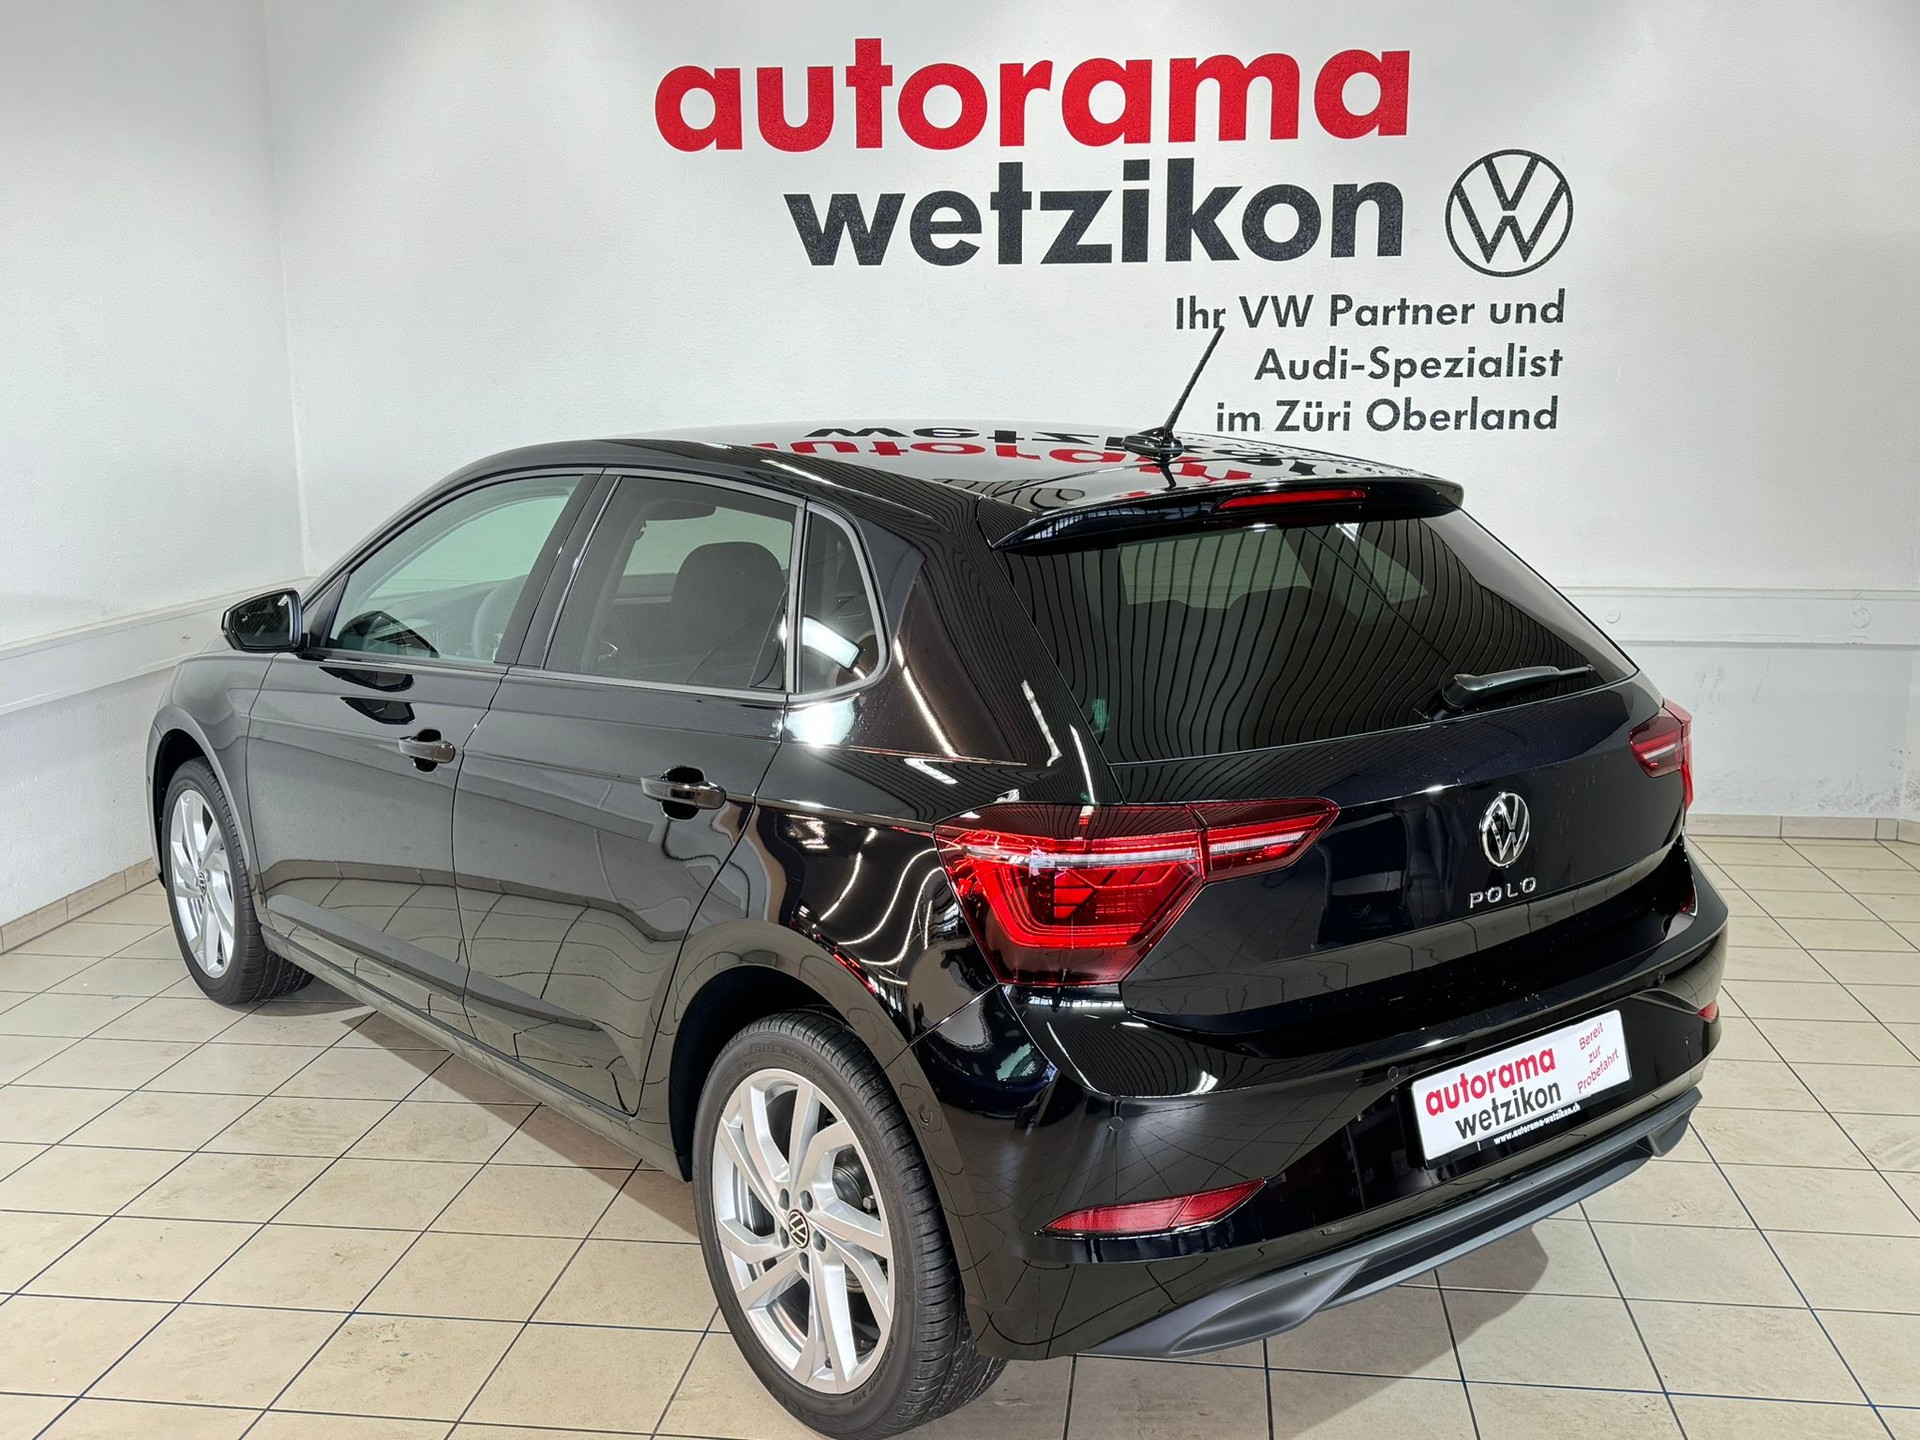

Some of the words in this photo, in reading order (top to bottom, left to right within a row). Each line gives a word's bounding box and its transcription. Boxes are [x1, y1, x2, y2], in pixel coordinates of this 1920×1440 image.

[656, 39, 1410, 152] autorama
[783, 158, 1403, 267] wetzikon
[1176, 295, 1226, 330] Ihr
[1239, 294, 1314, 329] VW
[1330, 294, 1475, 327] Partner
[1489, 288, 1565, 324] und
[1254, 343, 1563, 388] Audi-Spezialist
[1217, 402, 1261, 432] im
[1275, 399, 1351, 432] Züri
[1366, 395, 1558, 432] Oberland
[1470, 877, 1537, 909] POLO
[1579, 1022, 1604, 1050] Bereit
[1588, 1045, 1601, 1063] zur
[1425, 1048, 1556, 1116] autorama
[1577, 1048, 1619, 1094] Probefahrt
[1455, 1081, 1562, 1140] wetzikon
[1494, 1102, 1581, 1145] www.autorama-wetzikon.ch
